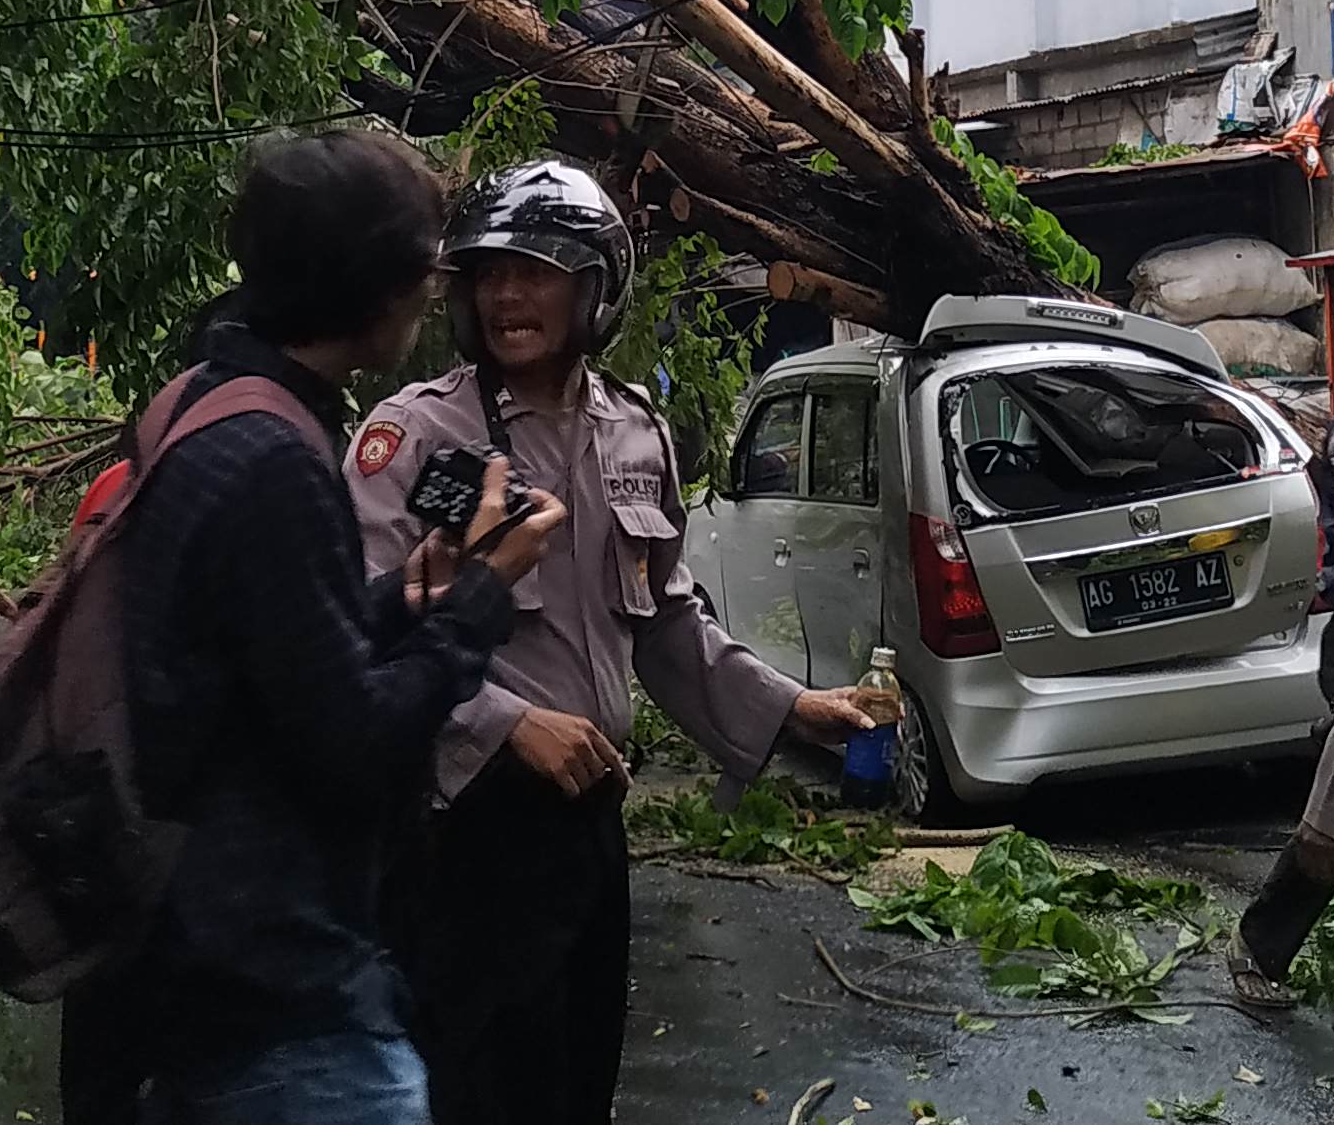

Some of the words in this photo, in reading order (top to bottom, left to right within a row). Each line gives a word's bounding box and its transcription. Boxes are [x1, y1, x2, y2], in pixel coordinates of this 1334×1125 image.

[609, 477, 658, 497] POLISI
[1088, 580, 1114, 608] AG
[1128, 567, 1180, 600] 1582
[1195, 558, 1222, 588] AZ
